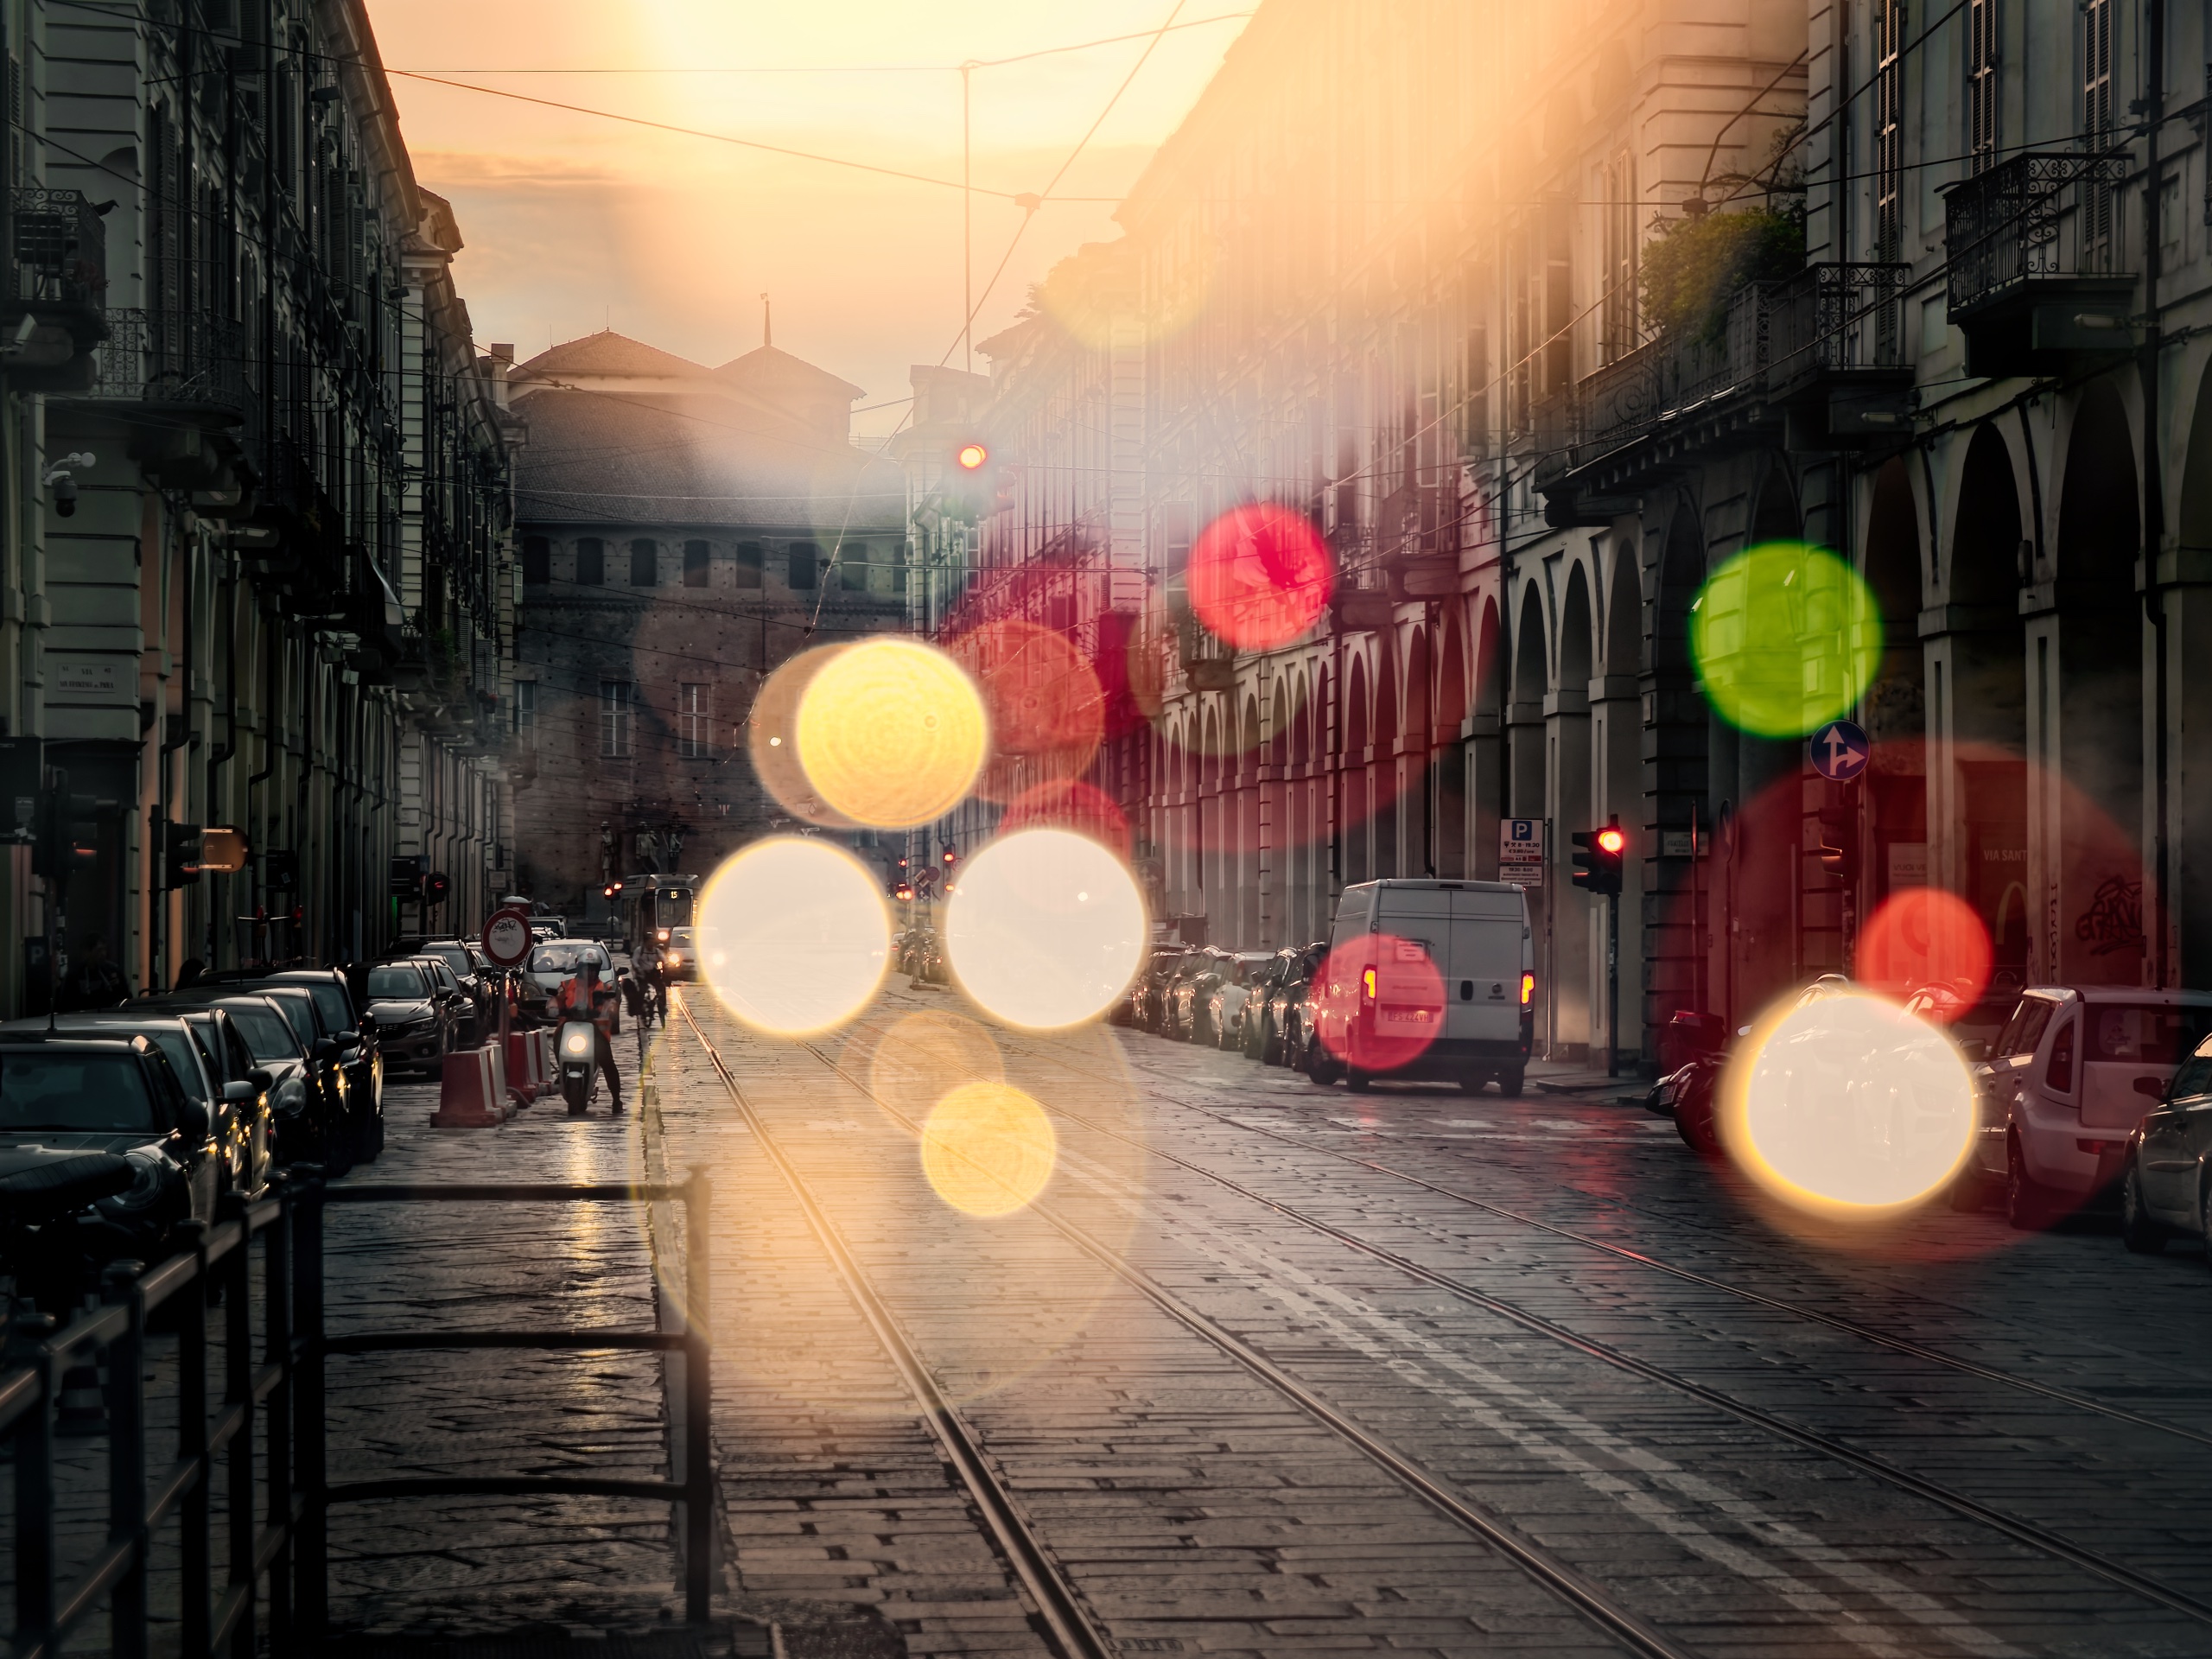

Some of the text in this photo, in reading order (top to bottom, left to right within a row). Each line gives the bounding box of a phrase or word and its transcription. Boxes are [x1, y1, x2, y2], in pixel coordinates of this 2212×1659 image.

[1516, 823, 1528, 838] P
[1984, 849, 1999, 861] VIA
[671, 891, 678, 899] 15
[30, 946, 45, 964] P
[1393, 1012, 1402, 1020] FS
